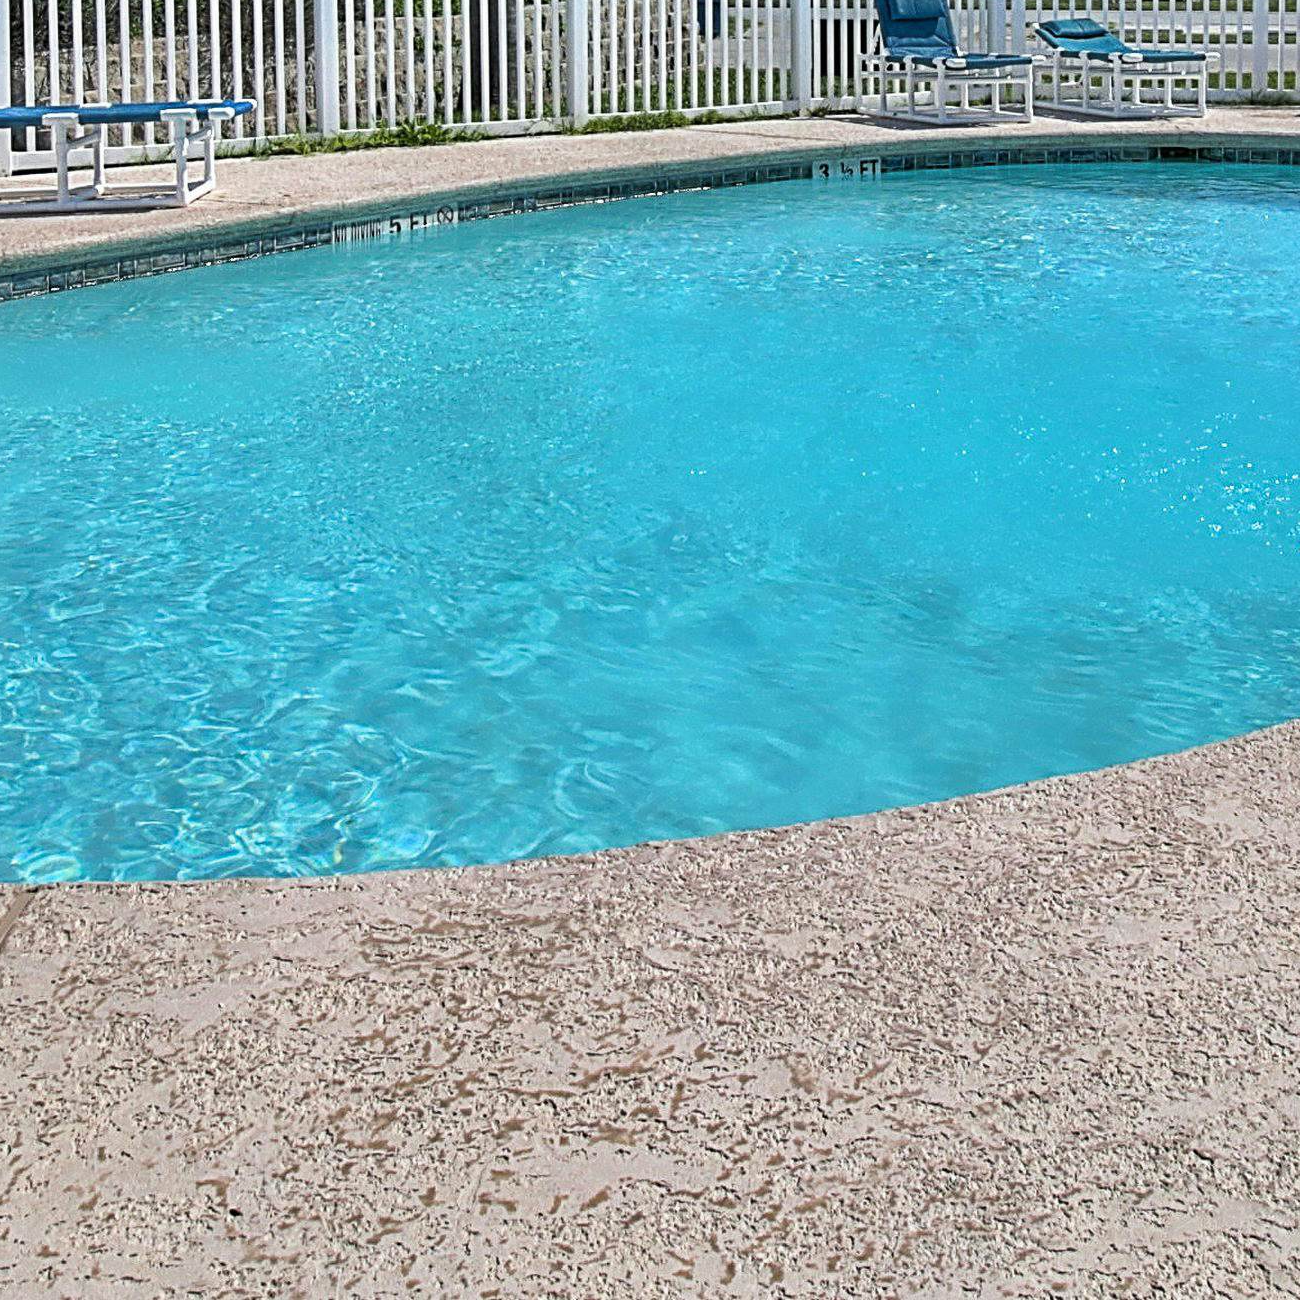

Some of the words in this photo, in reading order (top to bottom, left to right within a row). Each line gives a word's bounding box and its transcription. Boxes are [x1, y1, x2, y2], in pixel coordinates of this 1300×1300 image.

[820, 163, 829, 178] 3
[860, 159, 879, 175] FT
[389, 215, 401, 233] 5
